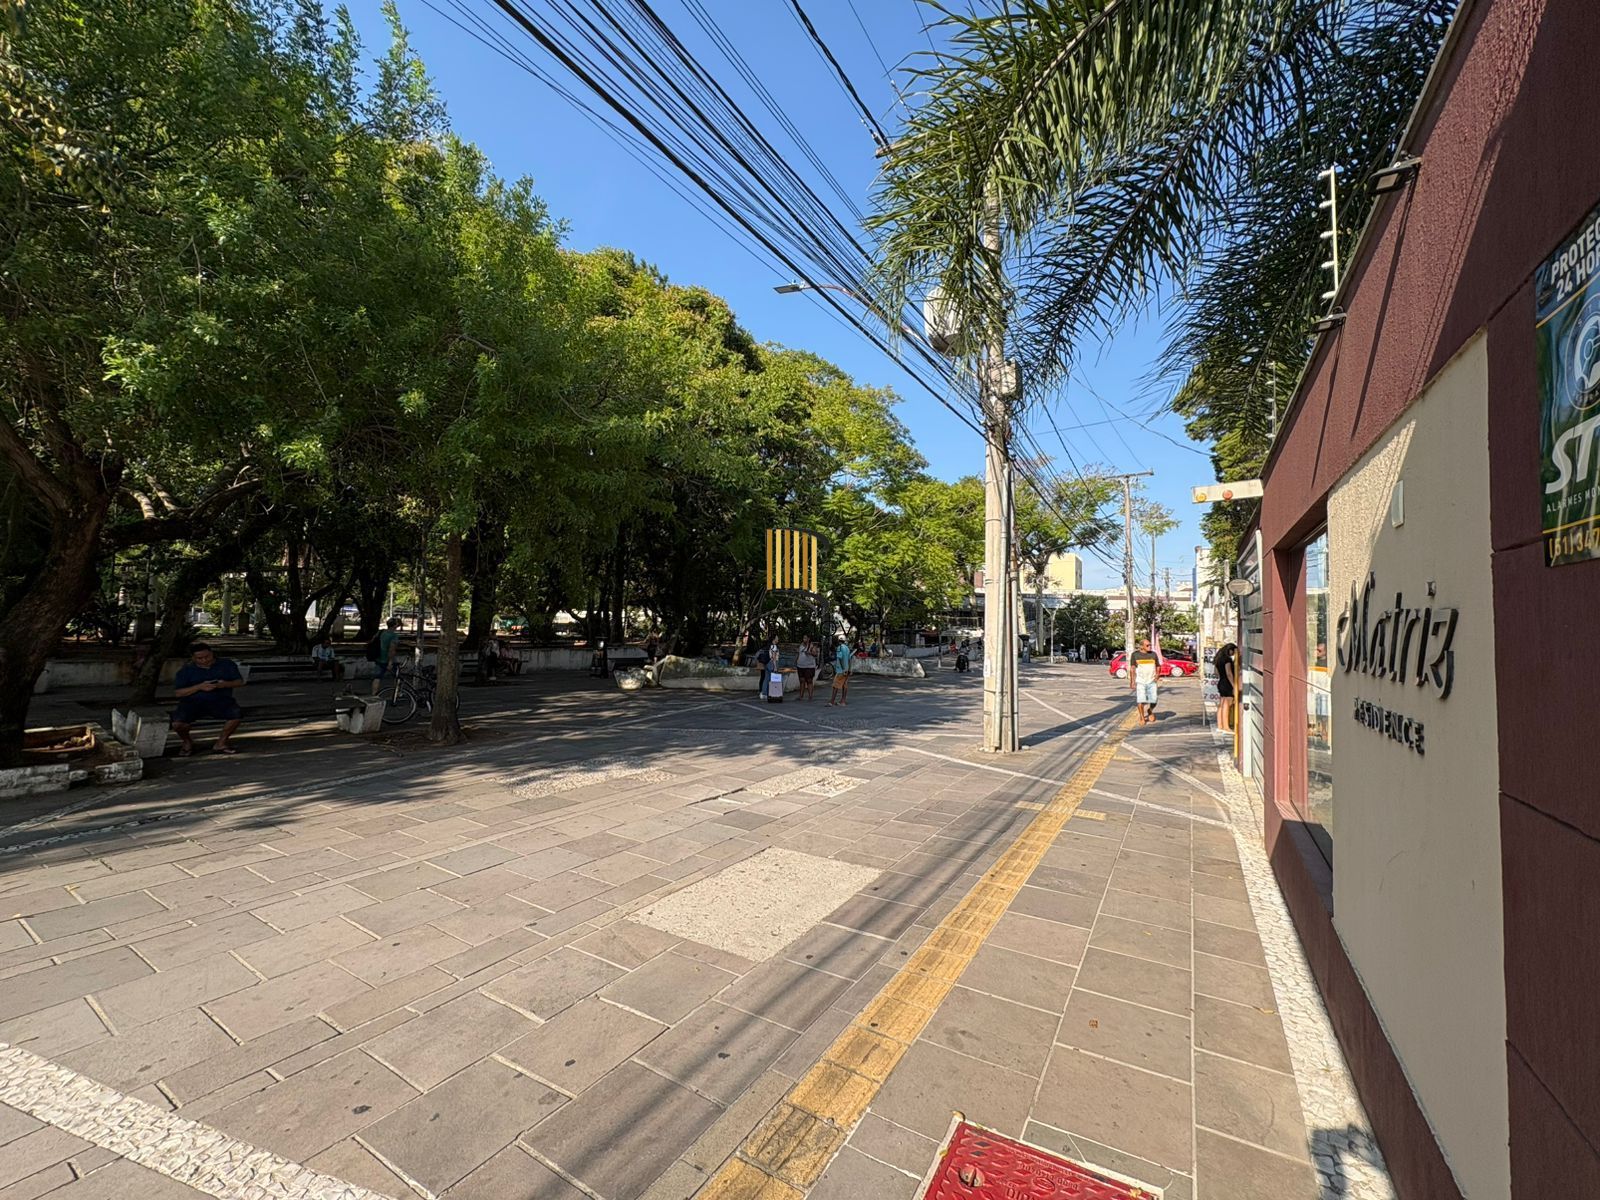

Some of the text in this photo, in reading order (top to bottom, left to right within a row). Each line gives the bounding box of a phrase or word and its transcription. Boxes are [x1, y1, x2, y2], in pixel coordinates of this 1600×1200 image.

[1556, 271, 1573, 302] 24
[1546, 492, 1582, 513] ALARMES
[1337, 571, 1458, 699] Matriz
[1353, 696, 1425, 755] RESIDENCE
